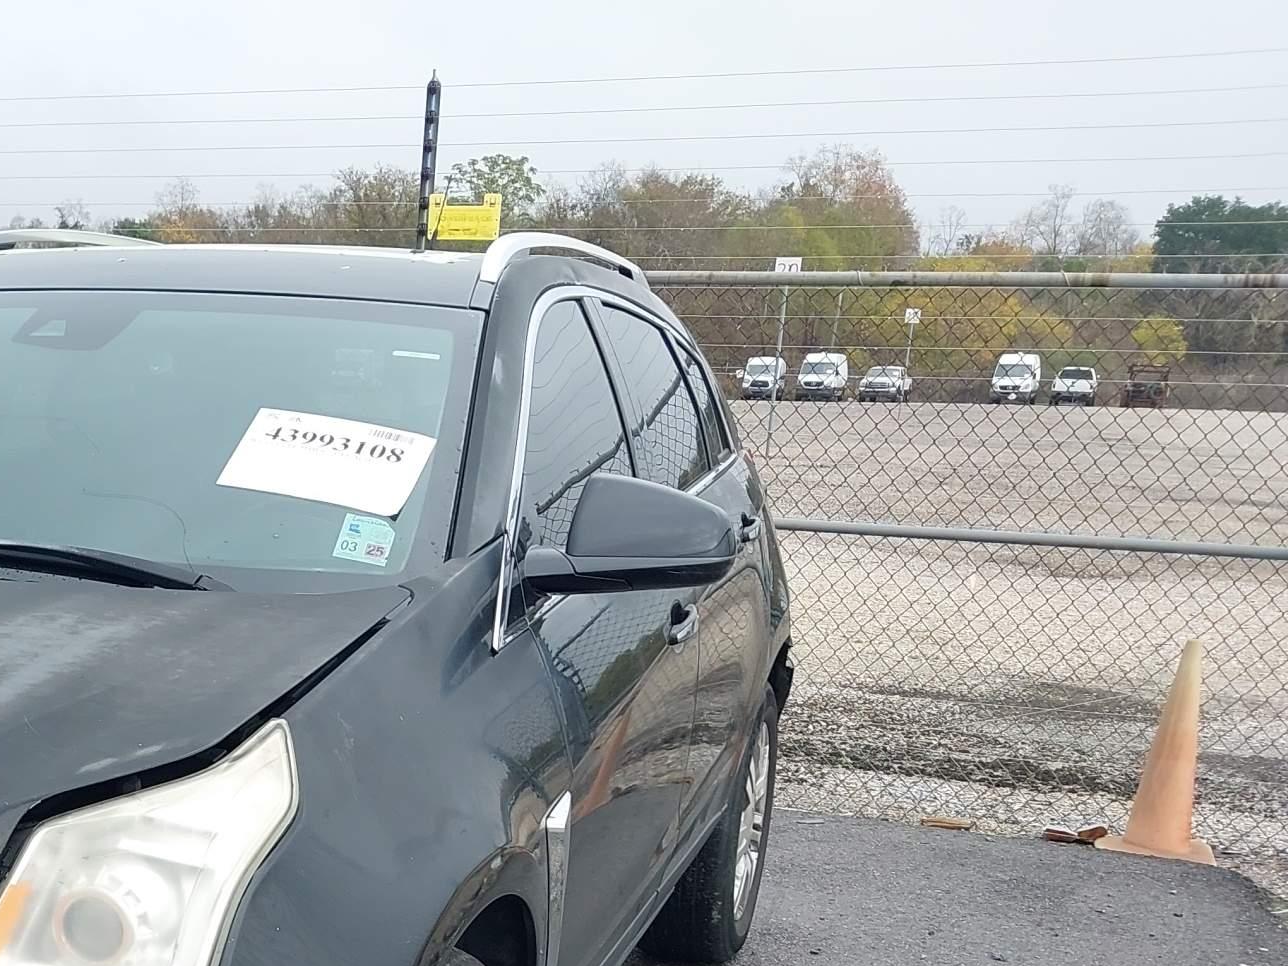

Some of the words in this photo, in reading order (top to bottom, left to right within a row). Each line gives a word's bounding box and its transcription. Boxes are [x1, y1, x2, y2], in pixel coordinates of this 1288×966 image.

[264, 425, 406, 464] 43993108
[340, 539, 359, 552] 03
[366, 544, 385, 557] 25
